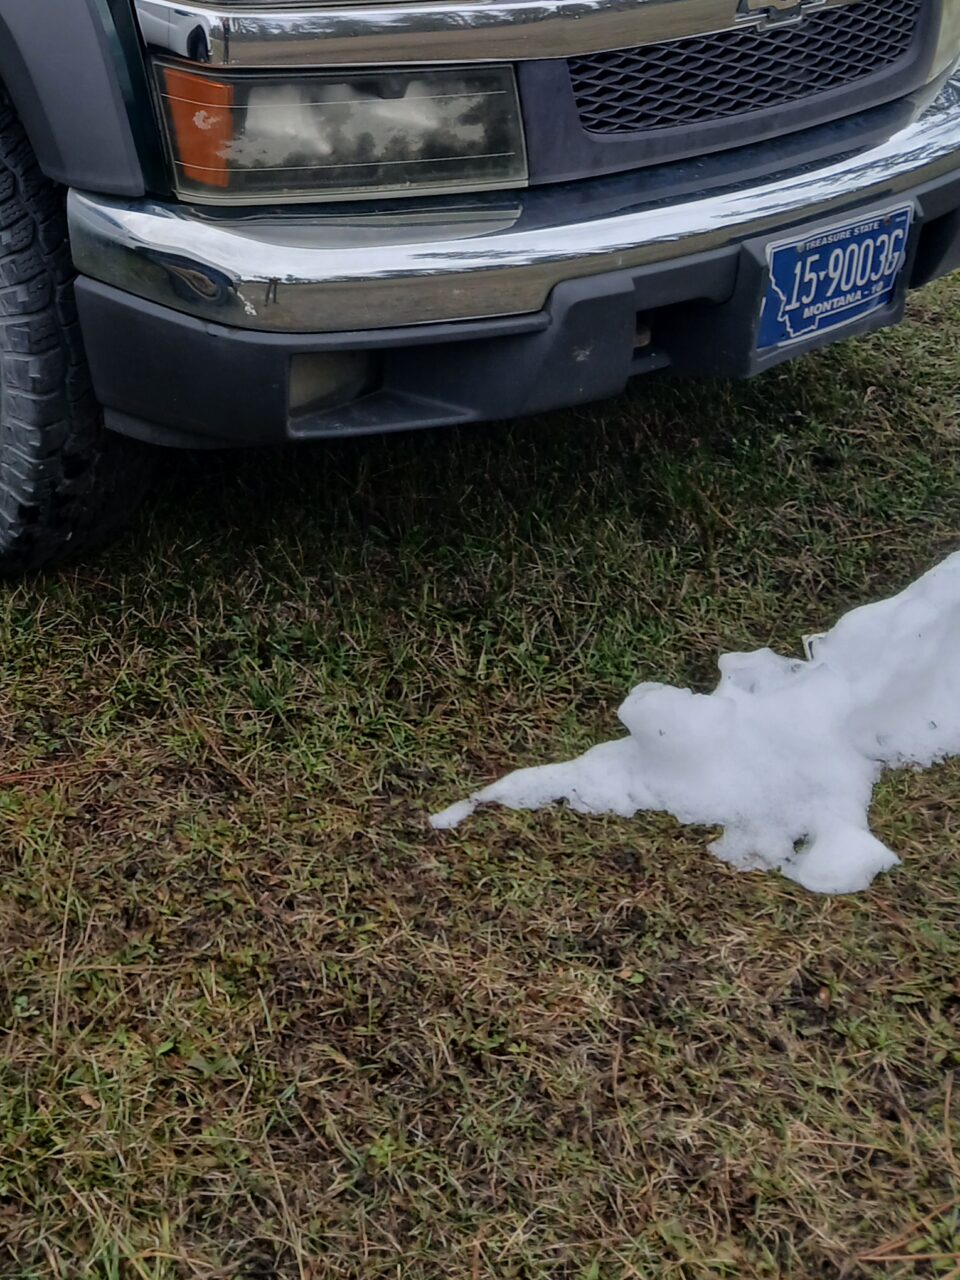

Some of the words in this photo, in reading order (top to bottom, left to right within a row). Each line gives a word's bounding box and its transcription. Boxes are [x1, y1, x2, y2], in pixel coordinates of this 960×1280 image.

[805, 230, 851, 250] TREASURE
[854, 222, 880, 236] STATE
[803, 290, 862, 320] MONTANA
